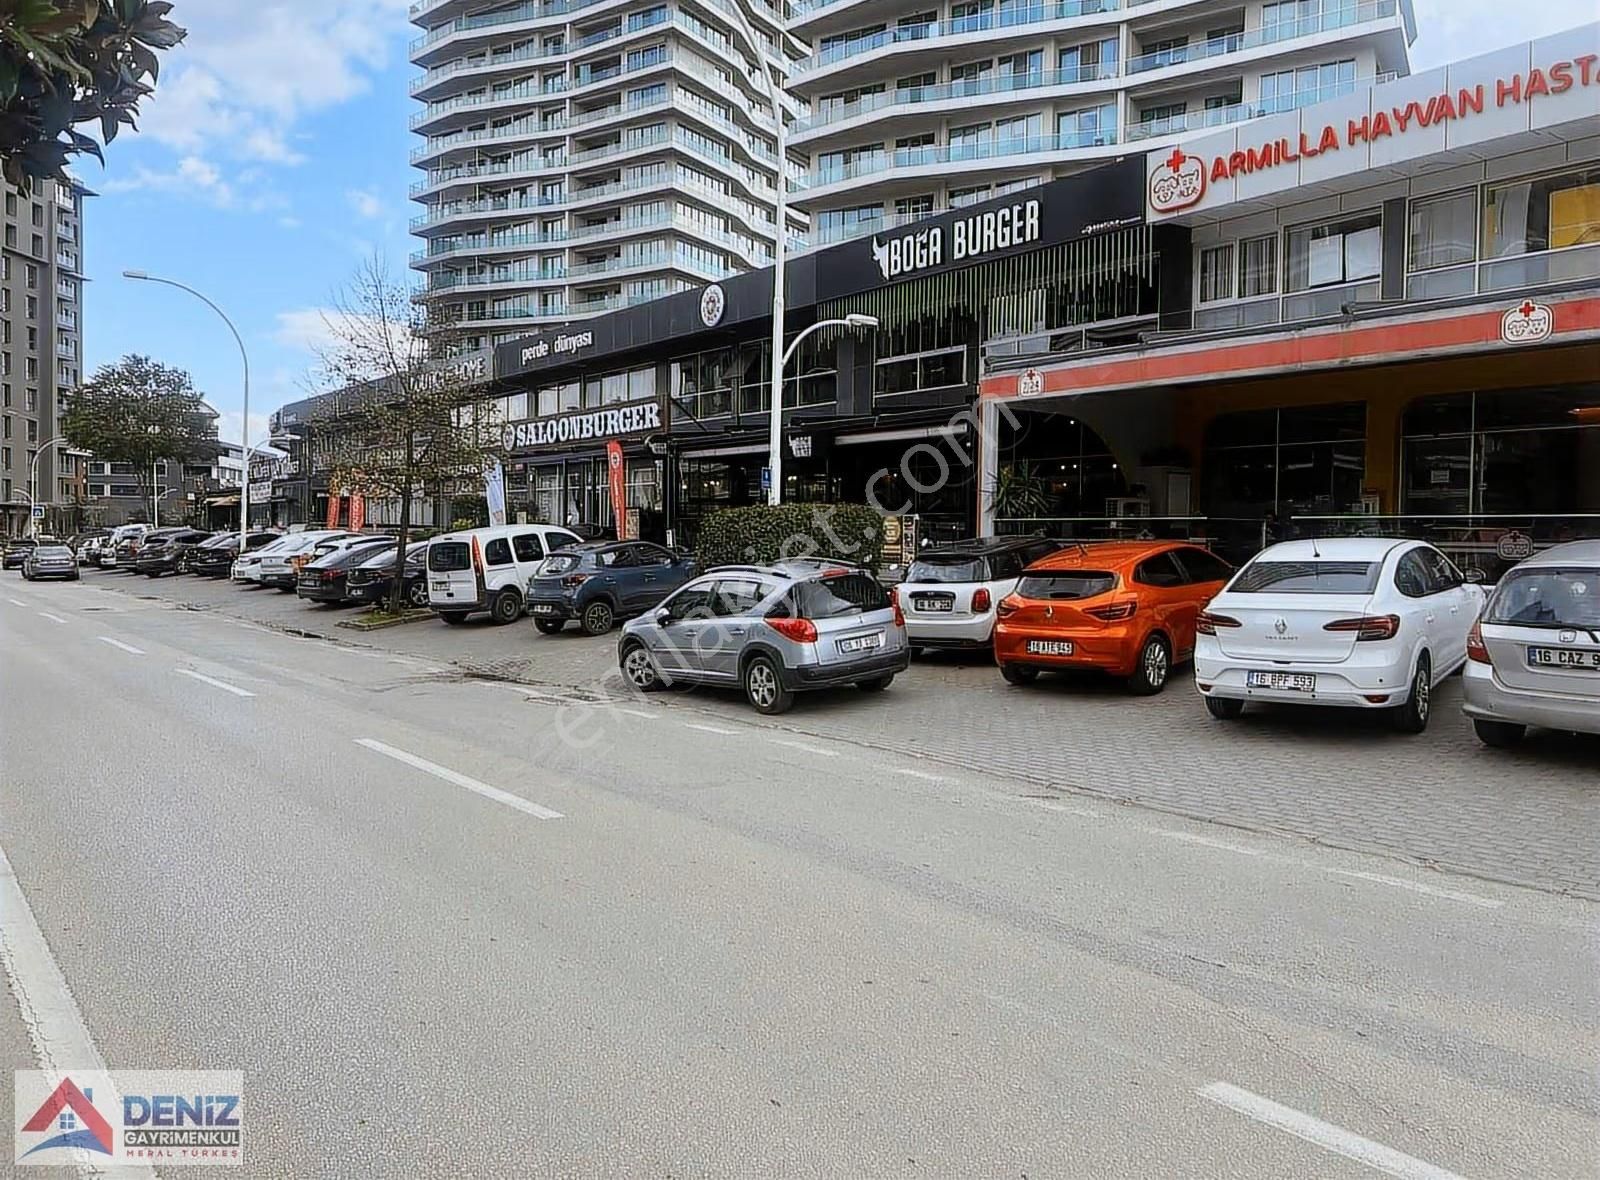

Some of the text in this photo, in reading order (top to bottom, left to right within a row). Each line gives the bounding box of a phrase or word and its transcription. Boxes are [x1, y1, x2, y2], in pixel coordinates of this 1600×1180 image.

[1348, 85, 1484, 146] HAYVAN
[953, 200, 1039, 260] BURGER
[521, 340, 549, 366] perde
[516, 402, 661, 448] SALOONBURGER
[1536, 649, 1552, 663] 16
[1558, 651, 1585, 665] CAZ
[1292, 675, 1313, 687] 593
